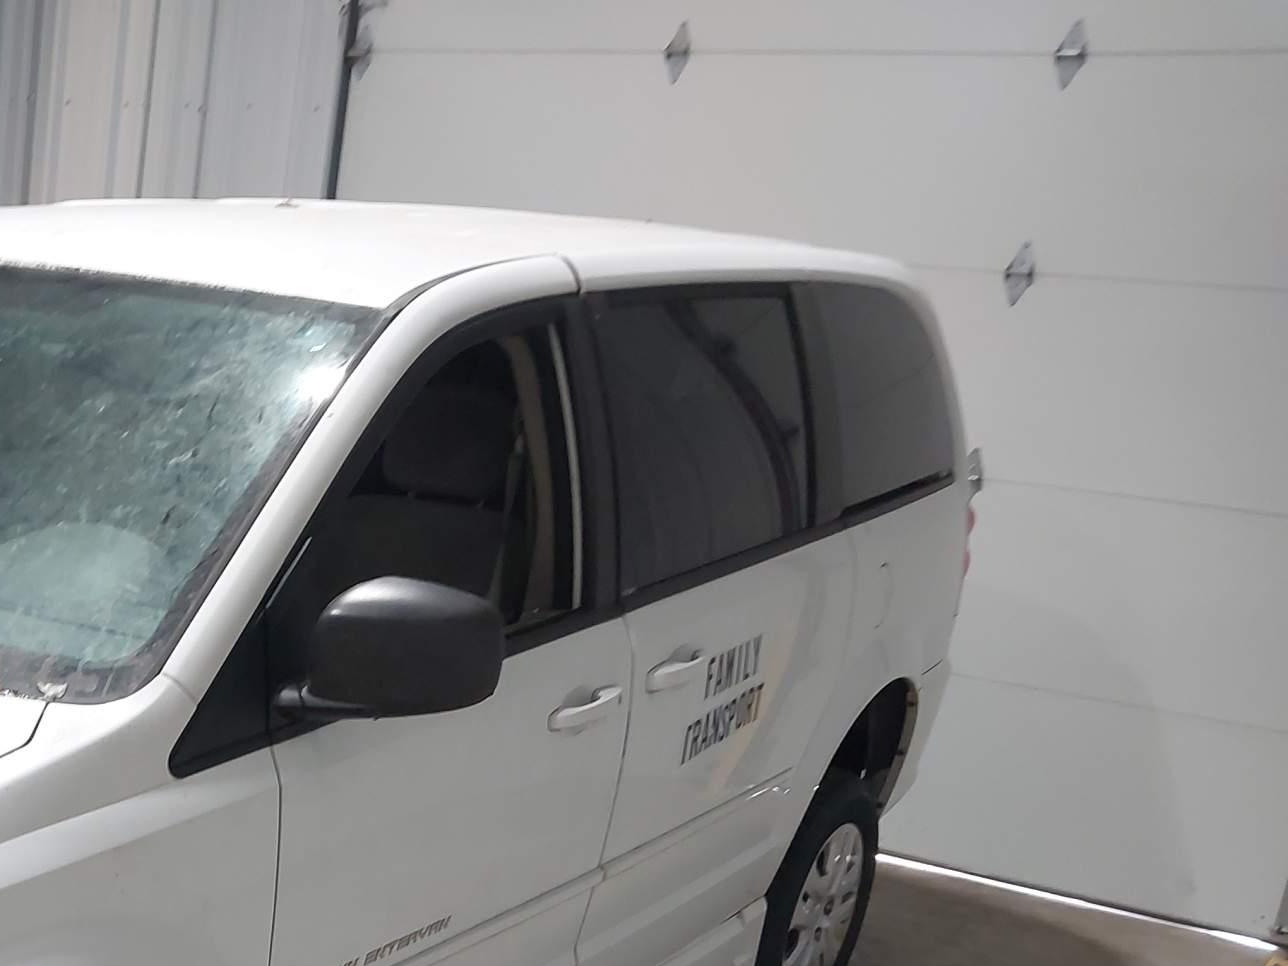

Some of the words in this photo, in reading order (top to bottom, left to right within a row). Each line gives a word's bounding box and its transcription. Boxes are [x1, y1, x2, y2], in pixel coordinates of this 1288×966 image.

[704, 633, 763, 700] FAMILY
[680, 682, 765, 766] TRANSPORT
[363, 915, 452, 966] ENTERVAN
